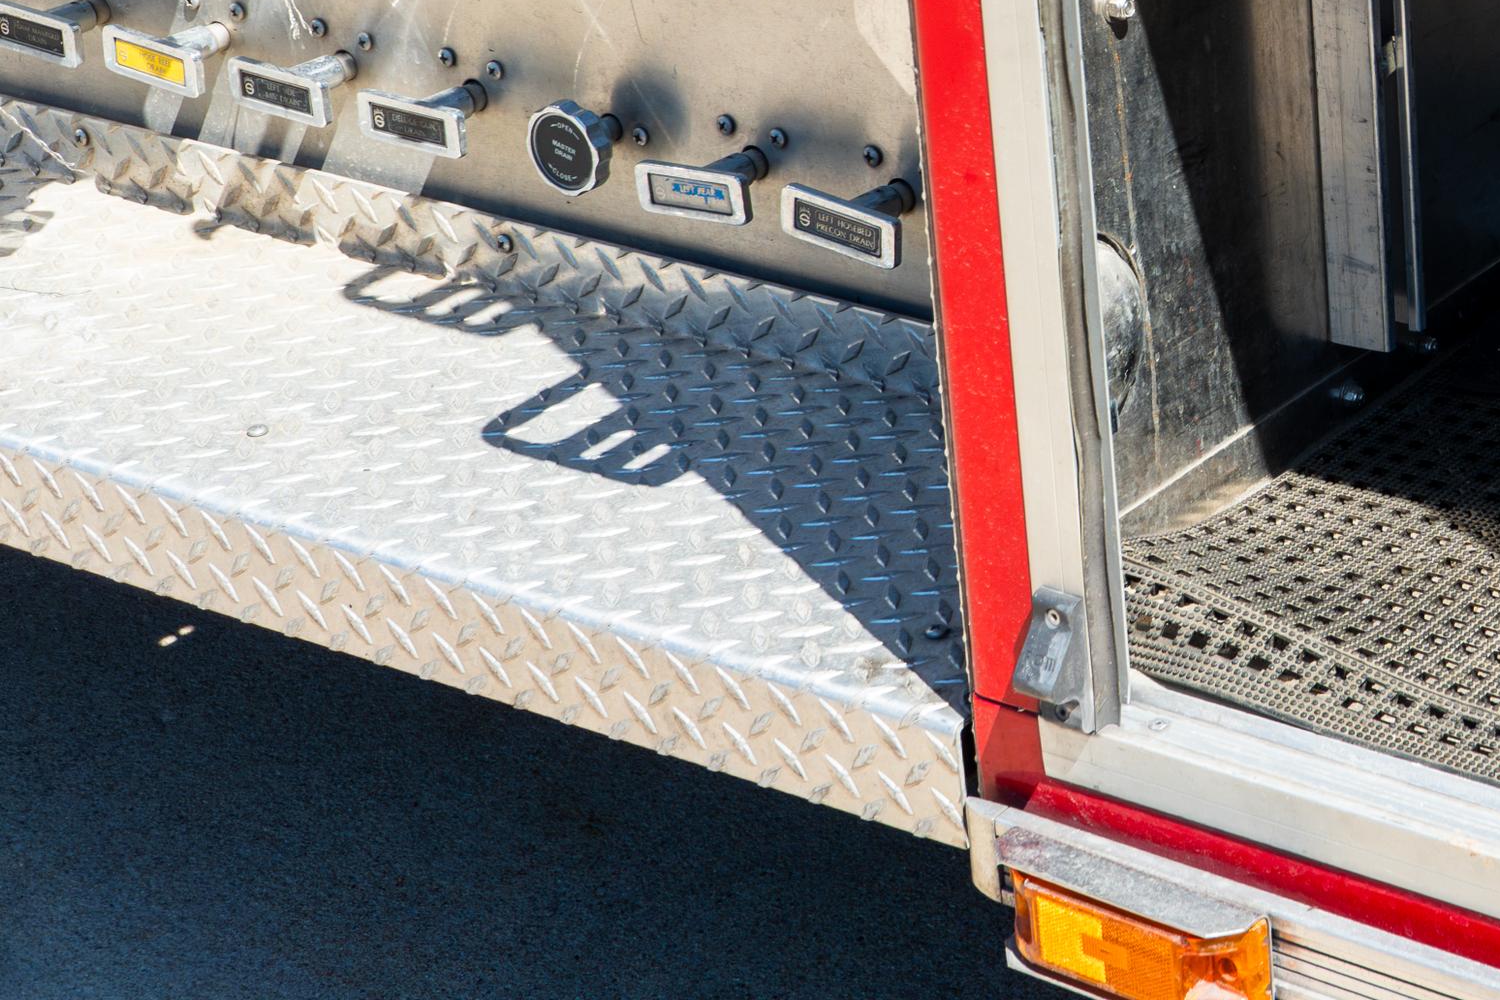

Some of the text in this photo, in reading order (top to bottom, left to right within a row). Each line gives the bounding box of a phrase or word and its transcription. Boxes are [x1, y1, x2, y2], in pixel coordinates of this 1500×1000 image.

[556, 122, 574, 134] OPEN
[552, 140, 577, 155] MASTER
[554, 148, 574, 161] DRAIN
[552, 167, 573, 181] CLOSE
[818, 212, 873, 238] LEFT HOSEBED
[816, 222, 875, 249] PRECON DRAIN
